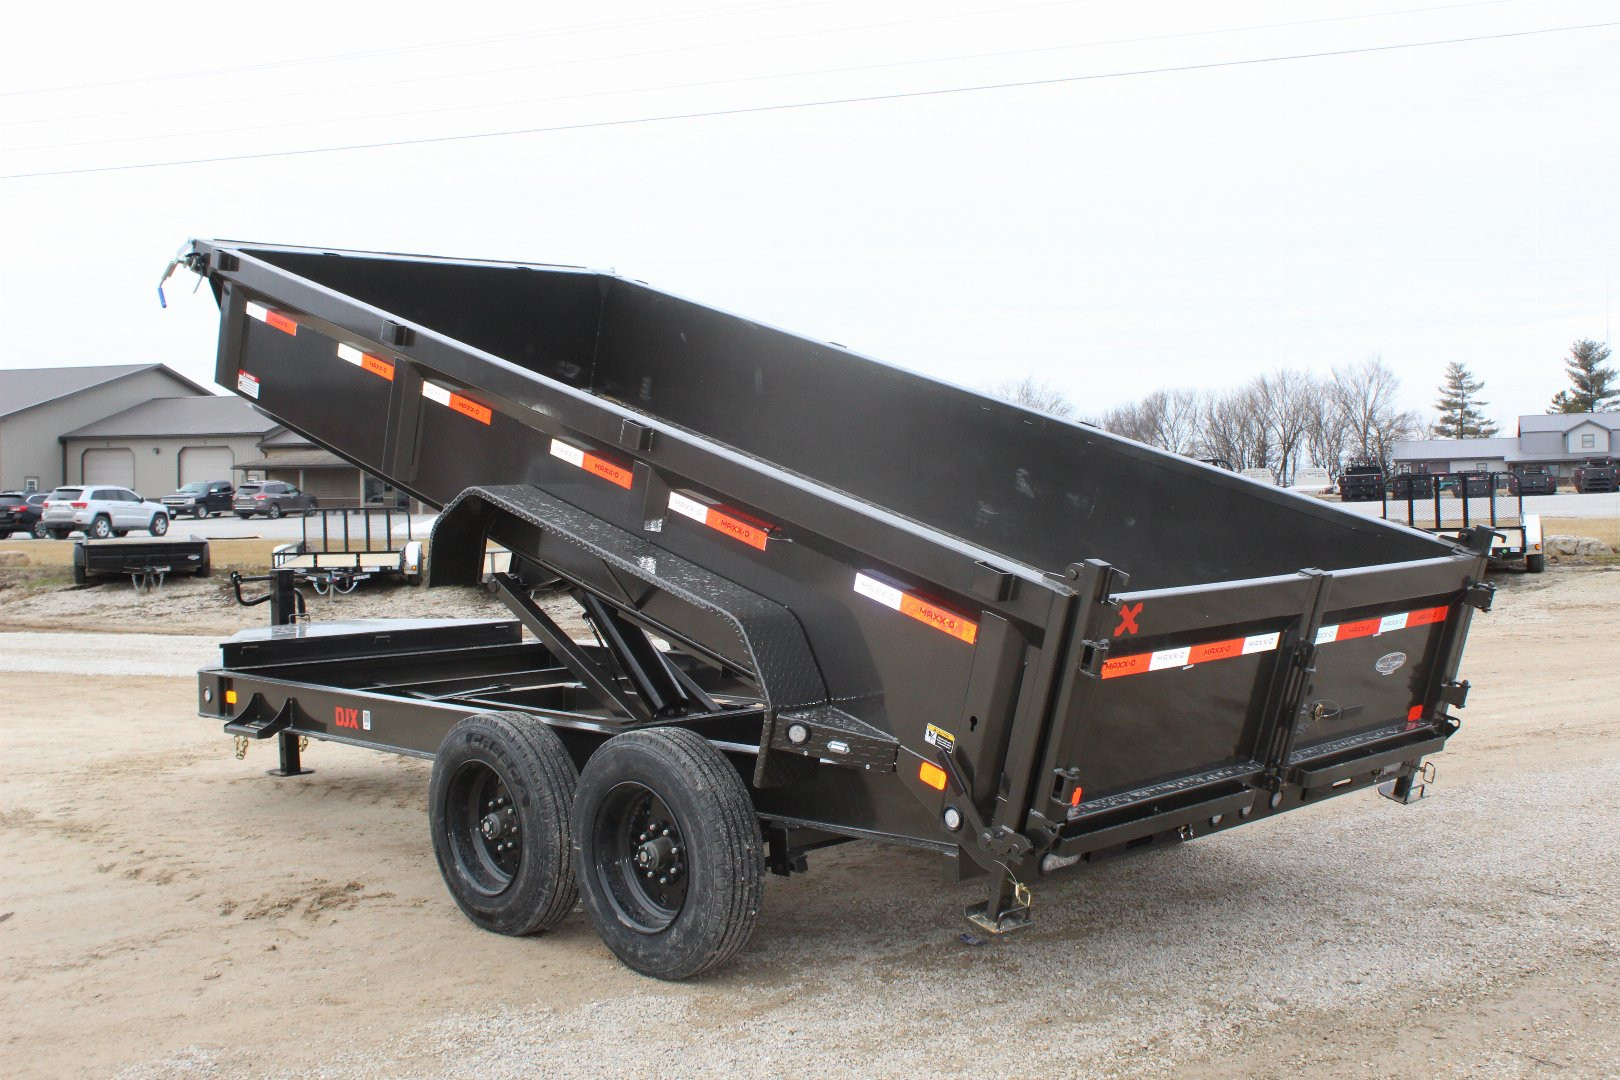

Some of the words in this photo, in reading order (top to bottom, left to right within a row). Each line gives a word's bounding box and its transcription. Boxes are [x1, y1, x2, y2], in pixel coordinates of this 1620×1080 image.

[594, 463, 620, 479] MAXX-D
[720, 520, 750, 538] MAXX-D
[919, 607, 956, 629] MAXX-D
[1113, 602, 1144, 637] X
[1105, 659, 1136, 671] MAXX-D
[1157, 651, 1185, 661] MAXX-D
[1204, 645, 1231, 656] MAXX-D
[335, 706, 359, 730] DJX
